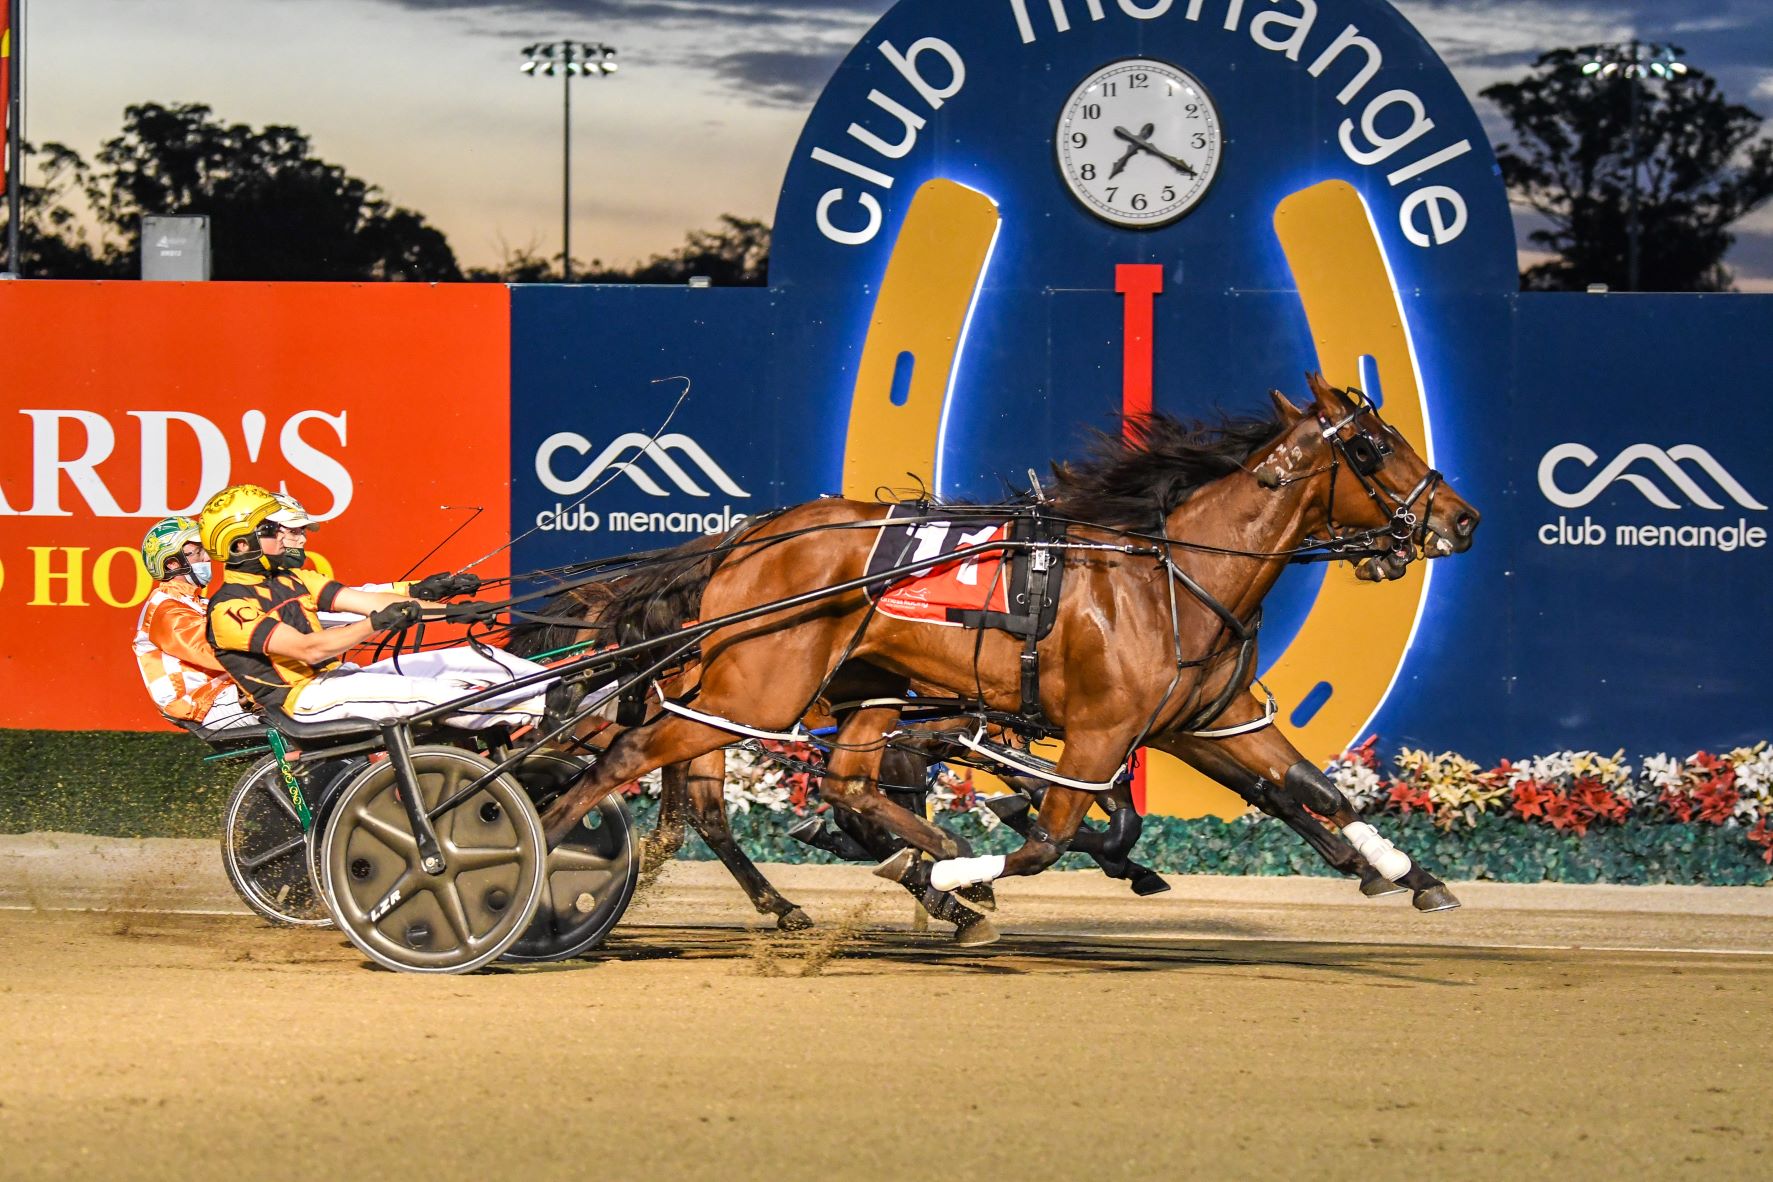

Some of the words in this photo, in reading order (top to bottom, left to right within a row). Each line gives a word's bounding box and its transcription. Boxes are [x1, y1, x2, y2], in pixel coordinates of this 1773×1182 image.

[1102, 82, 1117, 97] 11
[1128, 73, 1149, 89] 12
[1082, 104, 1101, 120] 10
[1185, 104, 1199, 119] 2
[811, 36, 966, 245] club
[1071, 132, 1087, 149] 9
[1191, 132, 1206, 149] 3
[1080, 163, 1096, 181] 8
[1105, 186, 1118, 203] 7
[1131, 193, 1147, 211] 6
[1161, 185, 1175, 202] 5
[0, 408, 354, 522] RD'S
[536, 503, 600, 532] club
[1538, 515, 1606, 545] club
[1616, 518, 1768, 552] menangle
[370, 889, 401, 922] LZR
